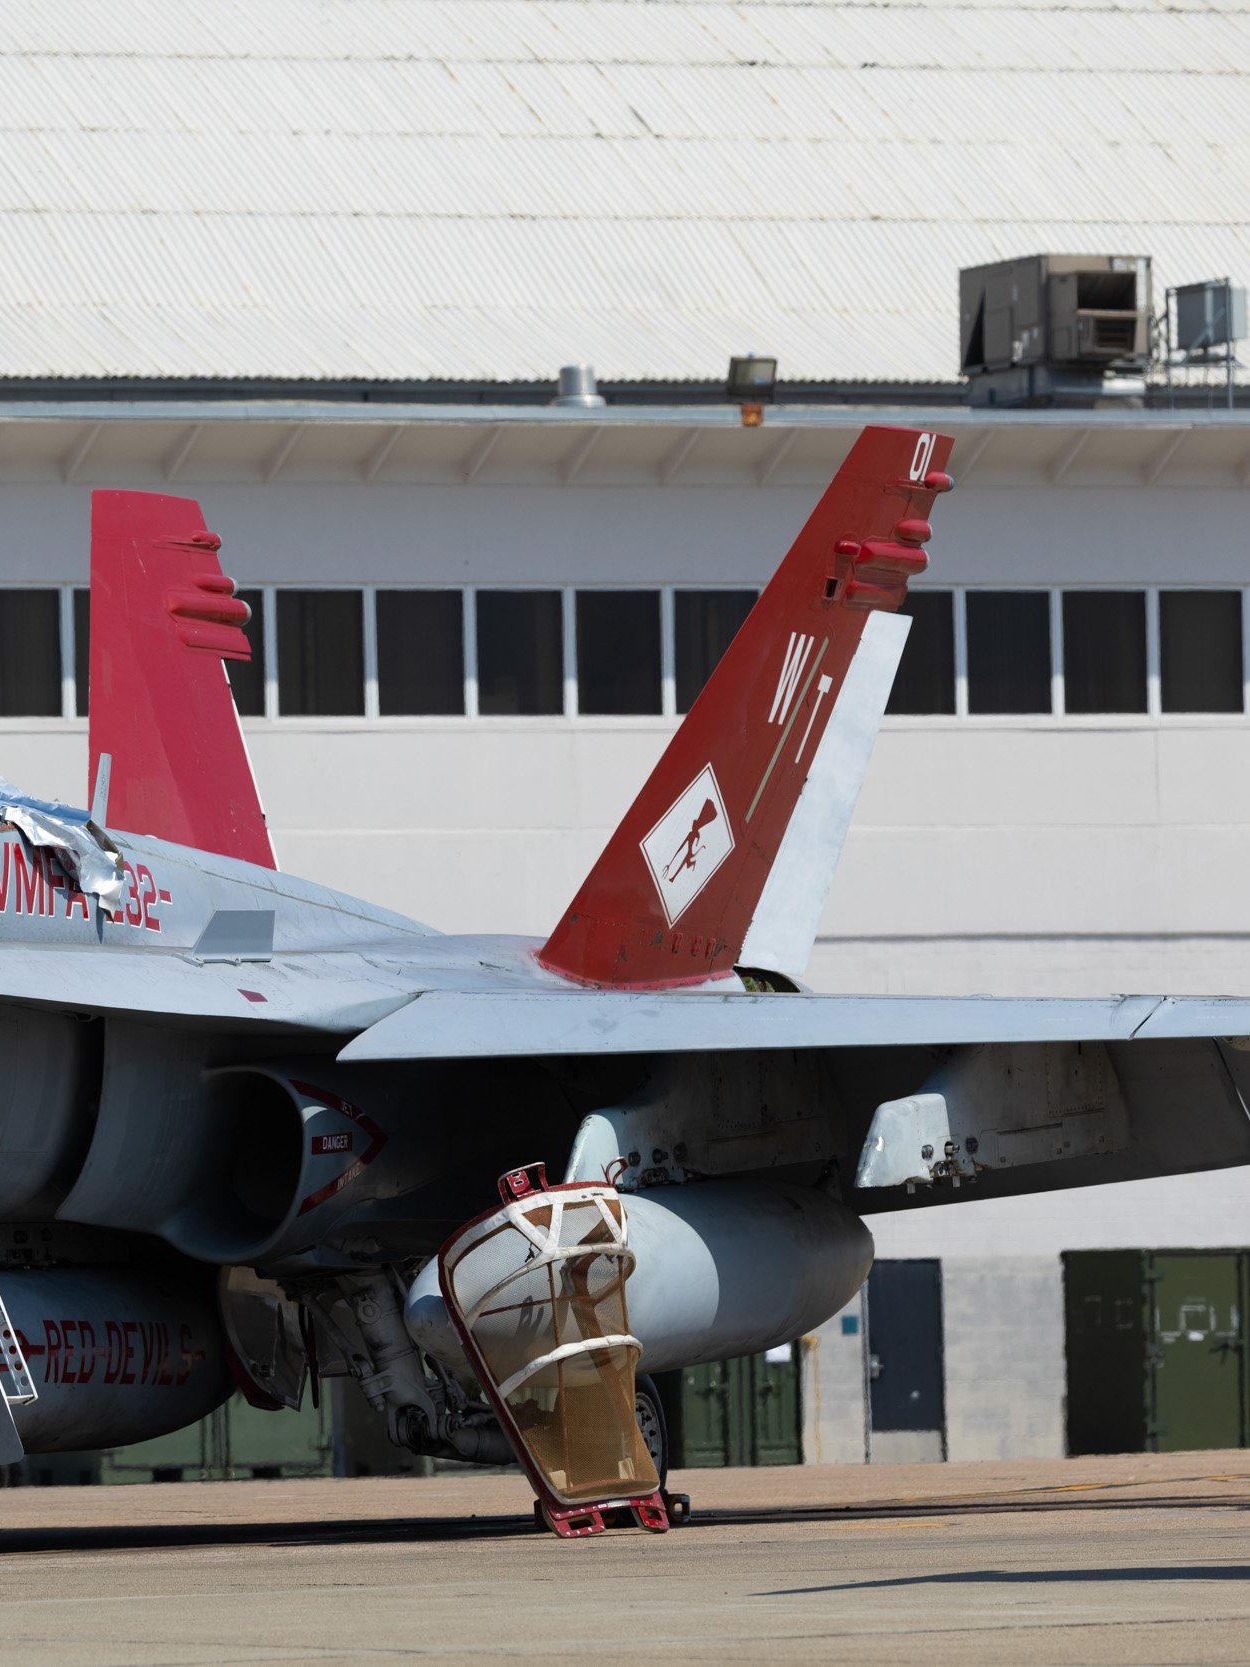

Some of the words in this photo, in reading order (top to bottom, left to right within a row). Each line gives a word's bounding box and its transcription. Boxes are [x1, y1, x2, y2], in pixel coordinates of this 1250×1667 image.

[910, 432, 937, 481] 01
[322, 1135, 349, 1151] DANGER
[336, 1161, 361, 1191] INTAKE
